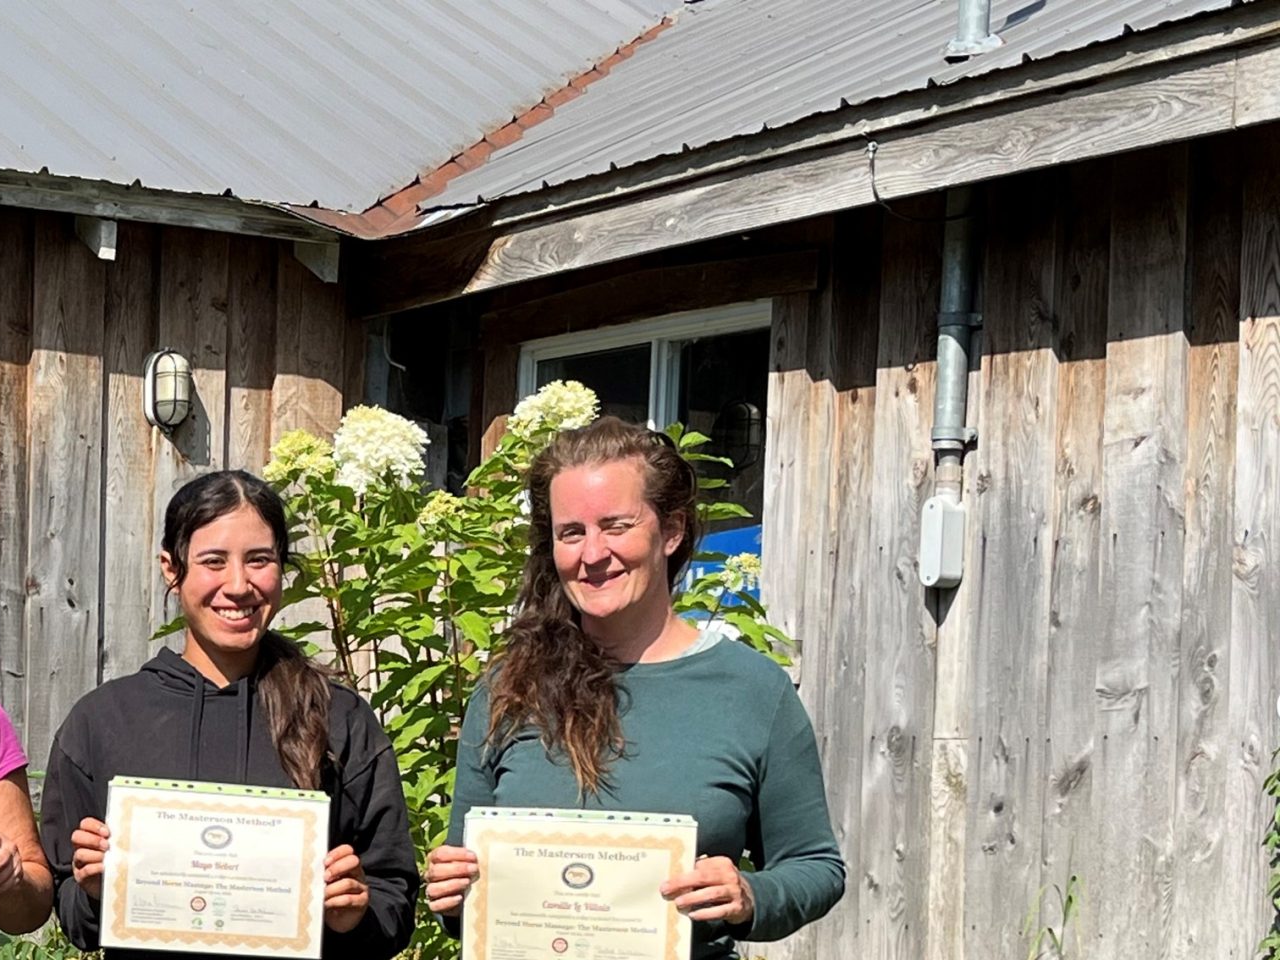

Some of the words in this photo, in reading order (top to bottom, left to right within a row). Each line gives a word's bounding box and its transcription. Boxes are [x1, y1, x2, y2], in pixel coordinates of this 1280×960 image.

[156, 811, 175, 820] The
[178, 813, 233, 824] Masterson
[514, 847, 534, 857] The
[537, 848, 595, 859] Masterson
